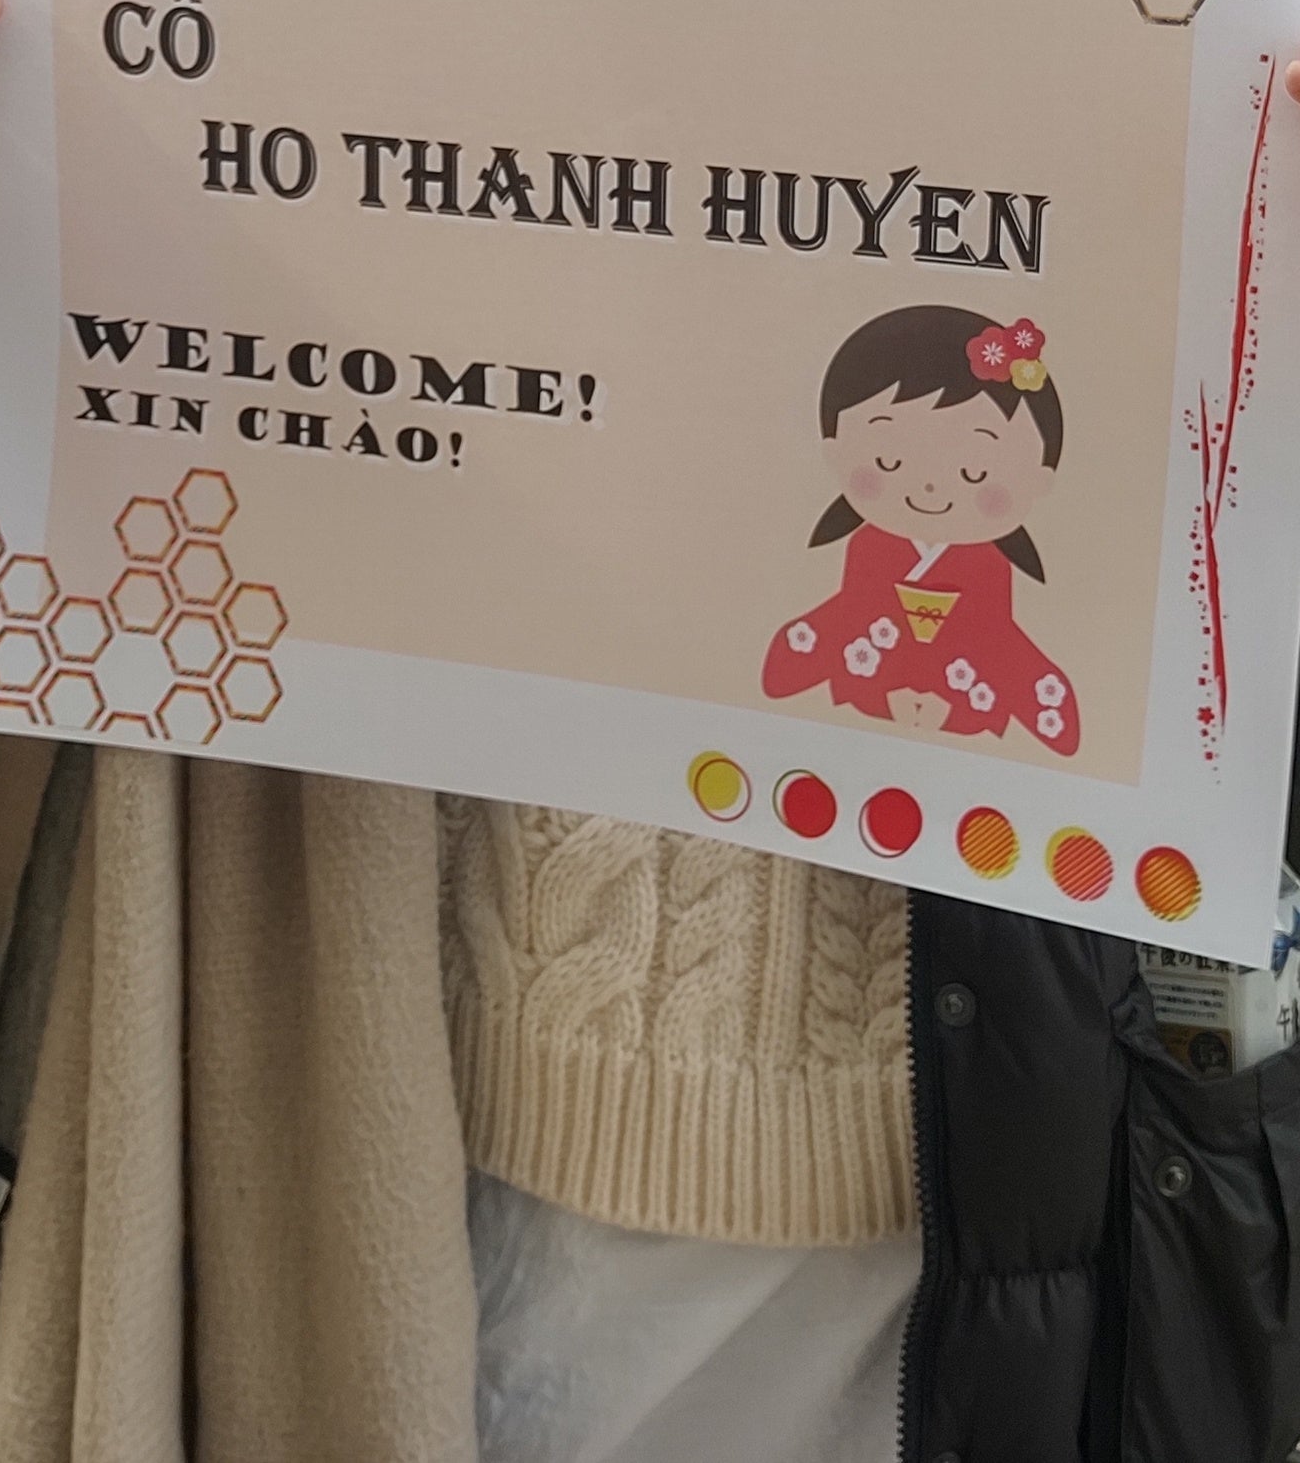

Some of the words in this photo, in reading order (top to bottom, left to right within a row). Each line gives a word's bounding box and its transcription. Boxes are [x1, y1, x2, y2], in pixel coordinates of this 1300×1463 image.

[199, 120, 318, 200] HO
[341, 133, 674, 236] THANH
[701, 165, 1052, 274] HUYEN
[67, 312, 603, 423] WELCOME!
[75, 385, 210, 435] XIN
[237, 407, 466, 468] CHÀO!
